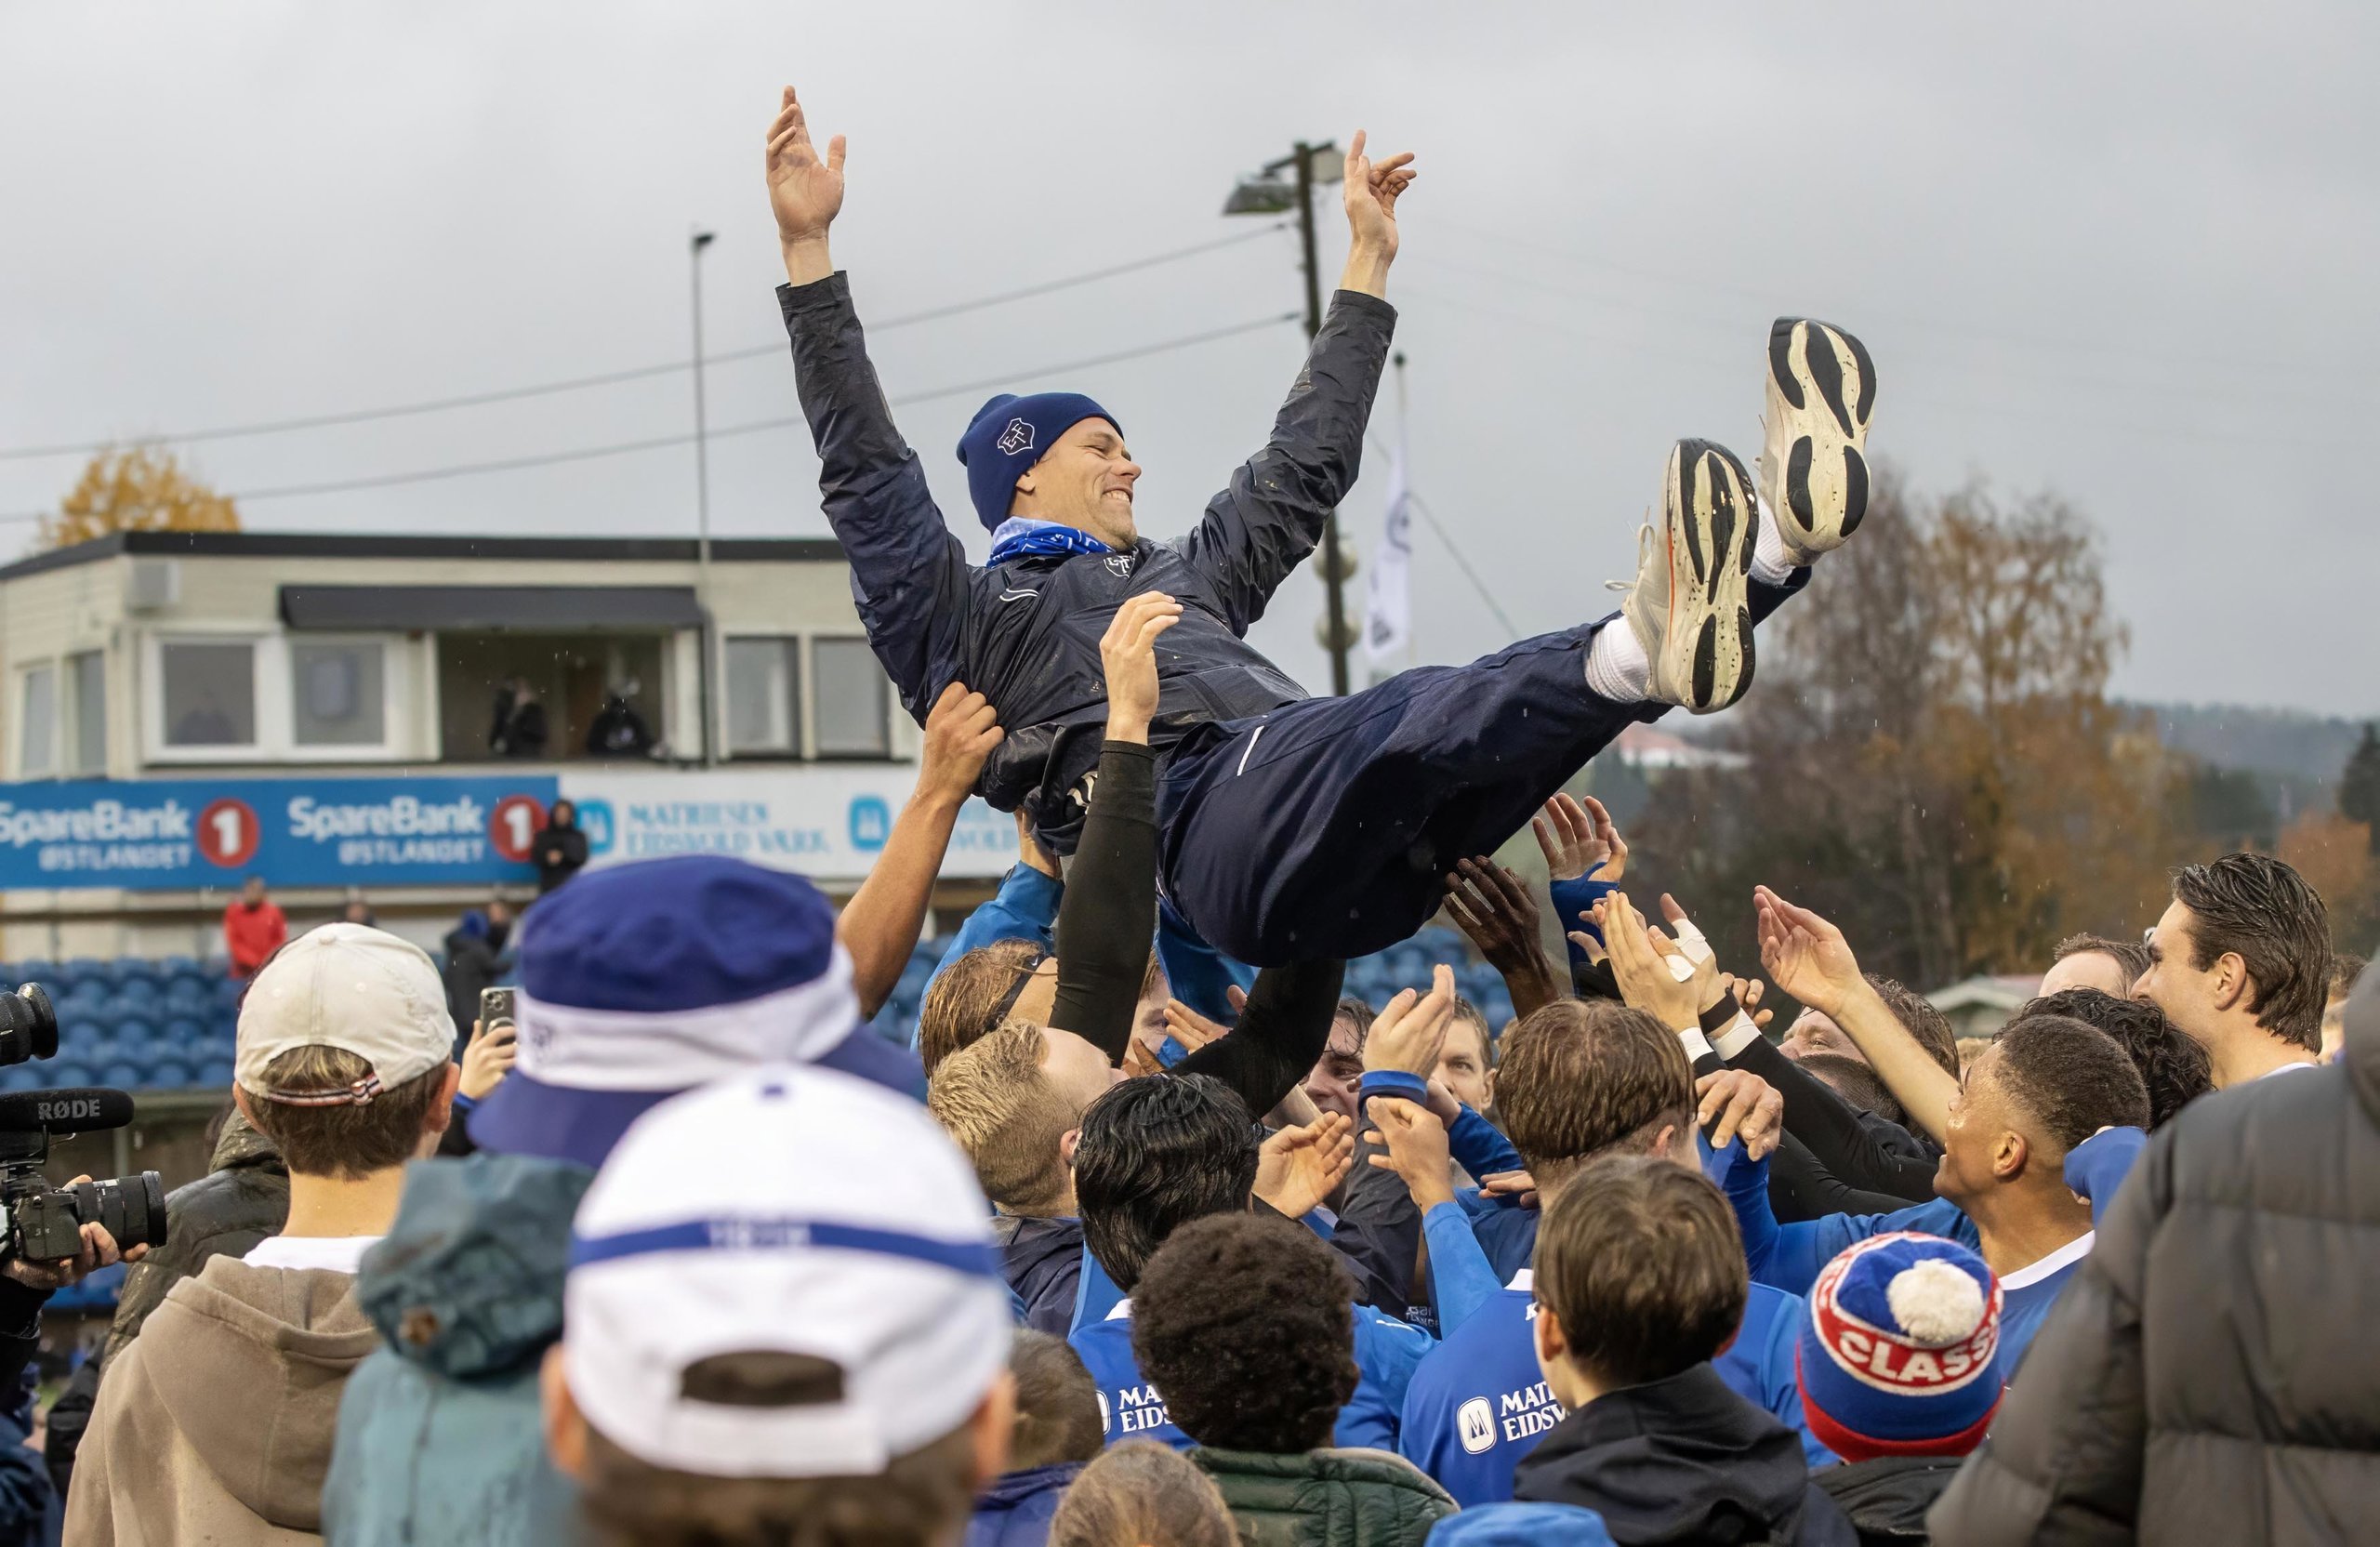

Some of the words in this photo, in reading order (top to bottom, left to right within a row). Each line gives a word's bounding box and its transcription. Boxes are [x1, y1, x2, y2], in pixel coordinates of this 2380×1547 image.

[212, 808, 242, 857] 1
[288, 795, 484, 842] SpareBank
[505, 804, 533, 851] 1
[38, 1099, 100, 1120] RØDE
